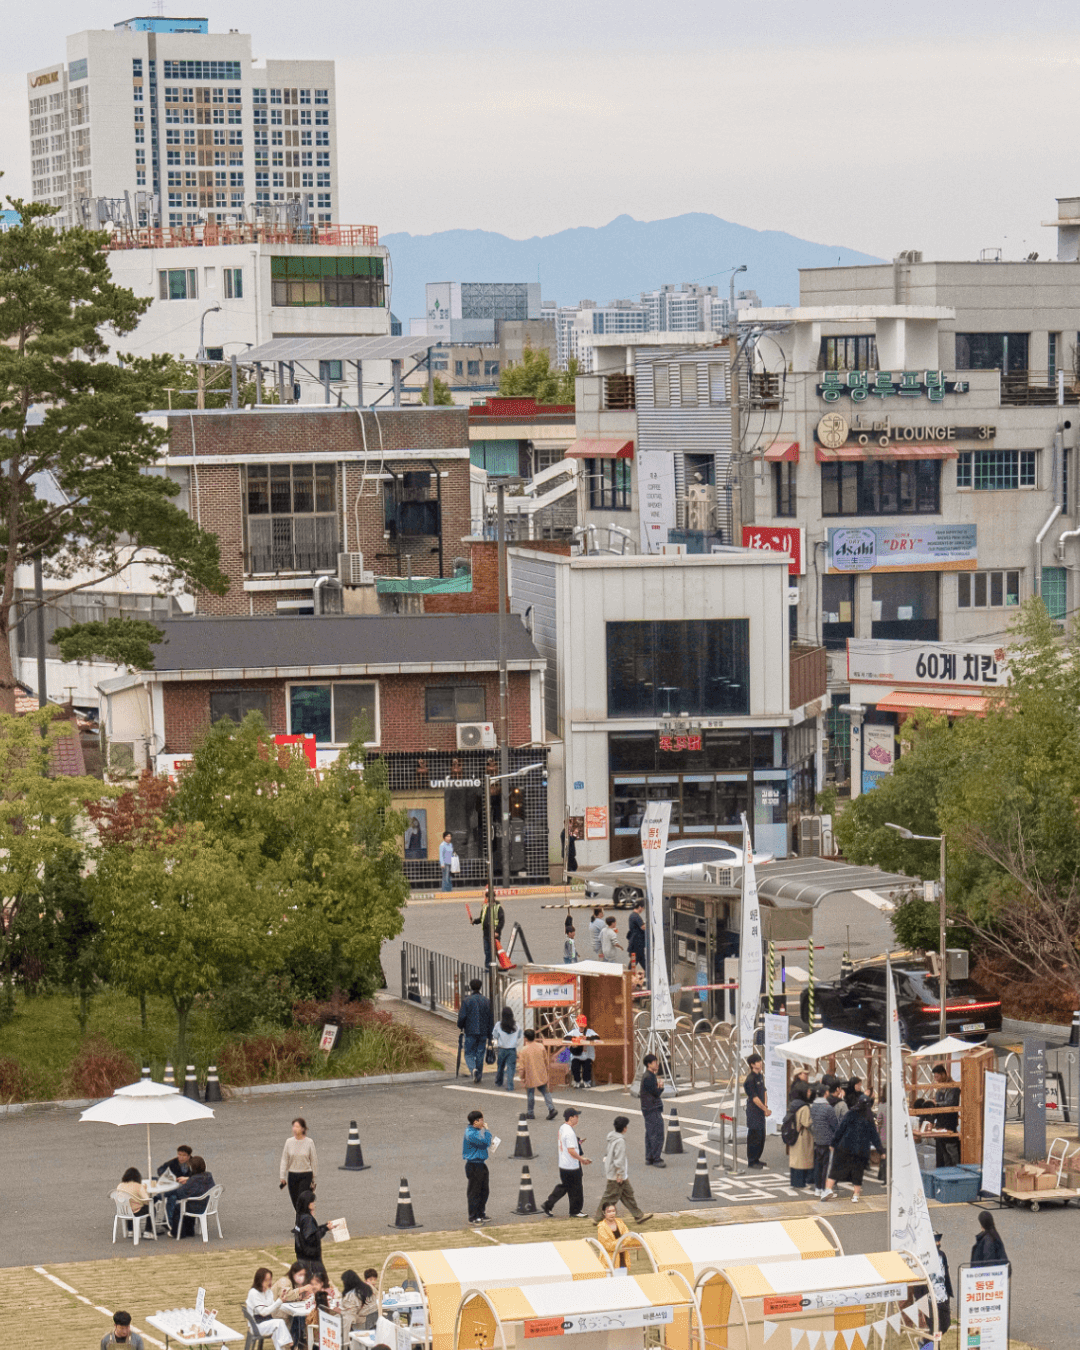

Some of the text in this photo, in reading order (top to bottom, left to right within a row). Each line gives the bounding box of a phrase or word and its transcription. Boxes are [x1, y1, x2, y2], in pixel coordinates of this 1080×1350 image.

[819, 370, 947, 403] 동명루프탑
[894, 426, 956, 441] LOUNGE
[978, 426, 996, 440] 3F
[834, 541, 875, 556] Asahi
[915, 652, 998, 683] 60계 치킨
[430, 775, 482, 788] unframe
[975, 1280, 995, 1291] 동명
[966, 1290, 1004, 1302] 커피산책
